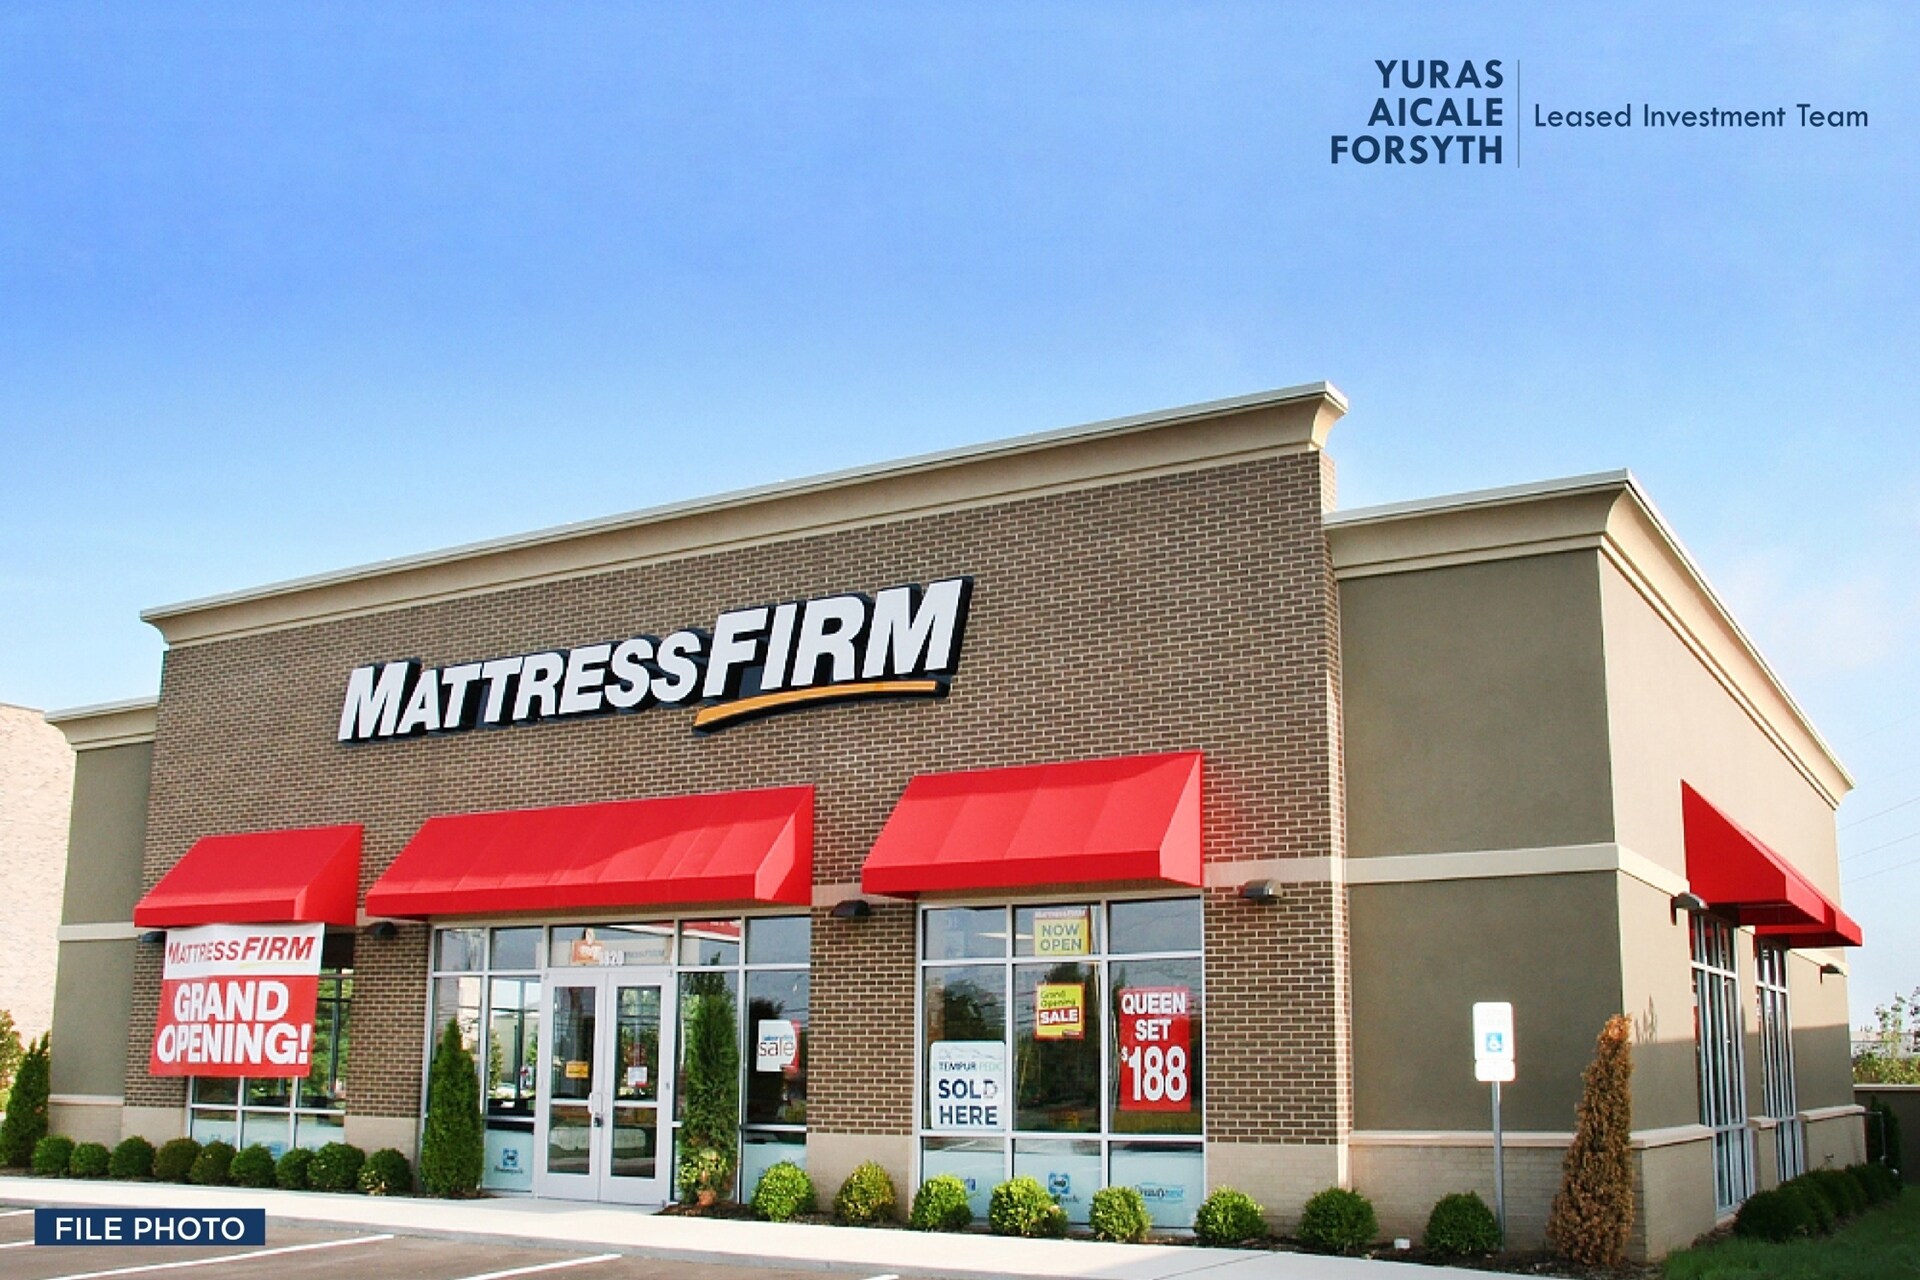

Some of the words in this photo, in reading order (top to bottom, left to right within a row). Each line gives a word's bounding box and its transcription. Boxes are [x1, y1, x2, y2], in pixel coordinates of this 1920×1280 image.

[1042, 924, 1080, 937] NOW
[1040, 938, 1082, 951] OPEN
[174, 980, 289, 1023] GRAND
[1121, 992, 1186, 1014] QUEEN
[1040, 1009, 1078, 1024] SALE
[1134, 1019, 1172, 1041] SET
[157, 1023, 312, 1065] OPENING!
[760, 1037, 794, 1056] sale
[938, 1079, 998, 1099] SOLD
[939, 1105, 998, 1125] HERE
